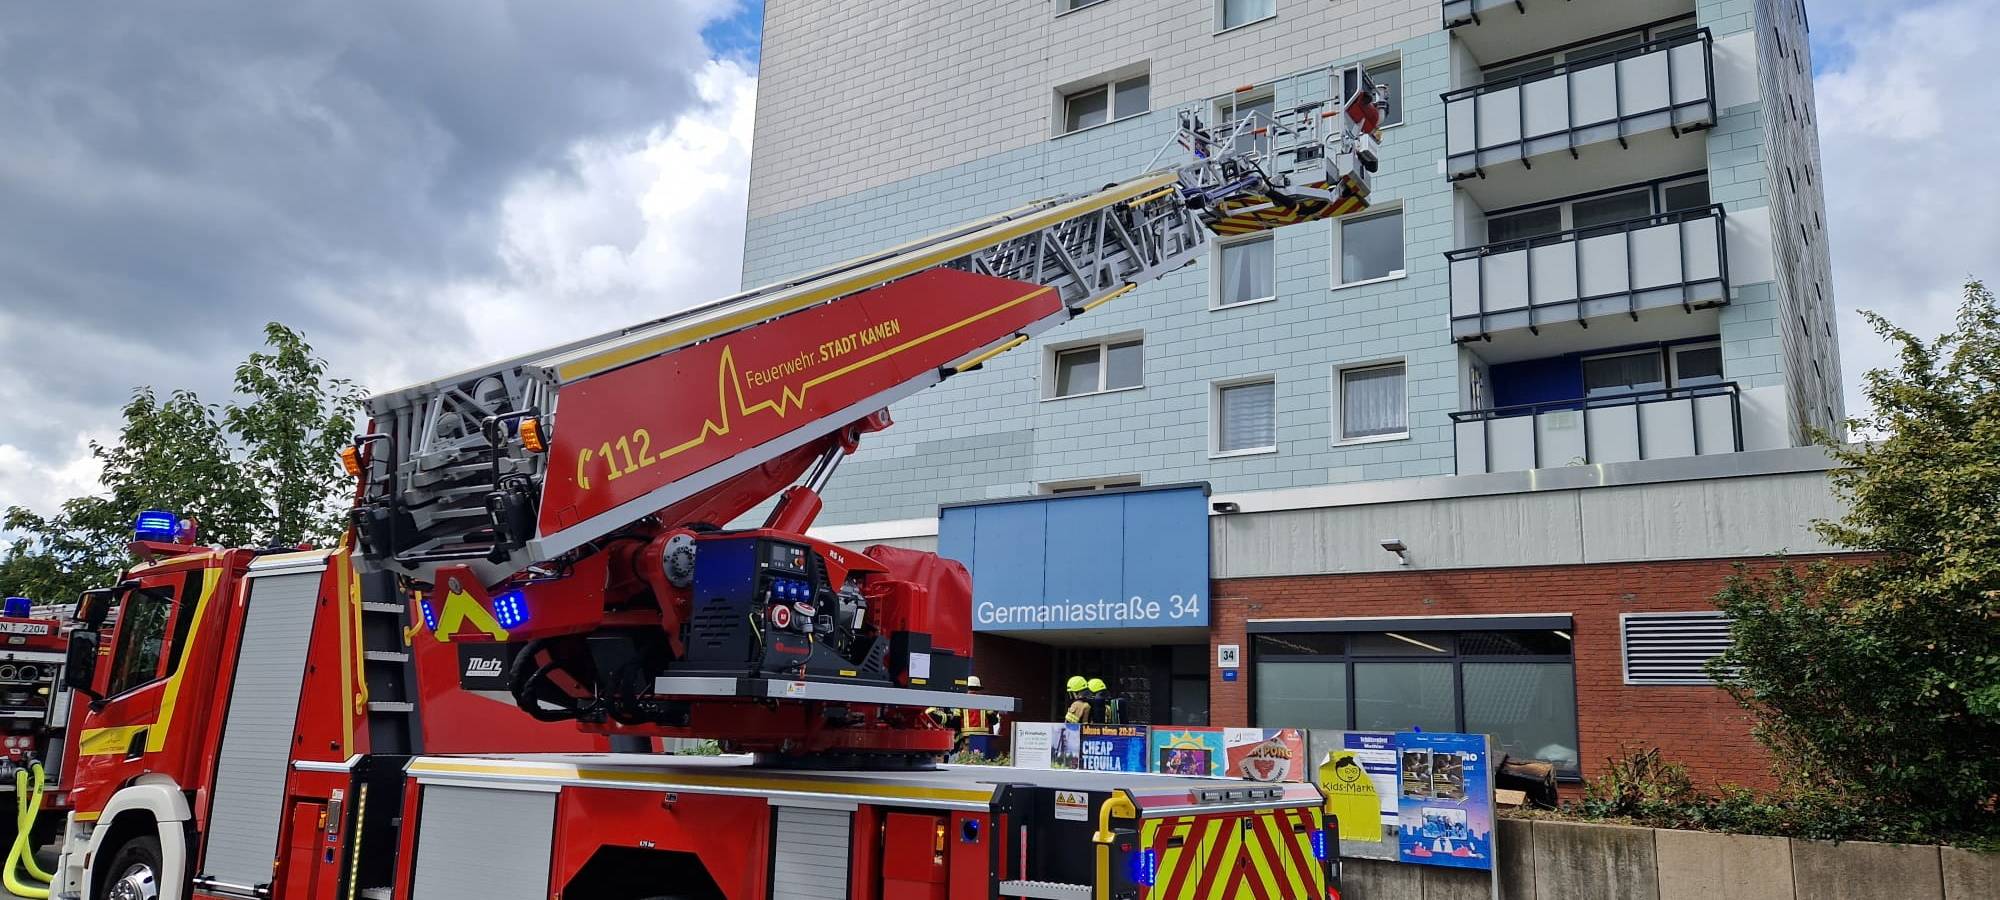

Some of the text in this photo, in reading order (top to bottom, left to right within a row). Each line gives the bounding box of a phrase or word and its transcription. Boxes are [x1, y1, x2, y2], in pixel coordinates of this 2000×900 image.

[745, 350, 815, 389] Feuerwehr
[860, 318, 901, 347] KAMEN
[599, 429, 656, 480] 112
[978, 594, 1200, 625] Germaniastraße 34
[22, 624, 46, 633] 2204
[1223, 650, 1234, 661] 34
[468, 657, 502, 671] Metz
[1082, 741, 1113, 755] CHEAP
[1264, 746, 1292, 760] PONG
[1082, 756, 1121, 771] TEQUILA
